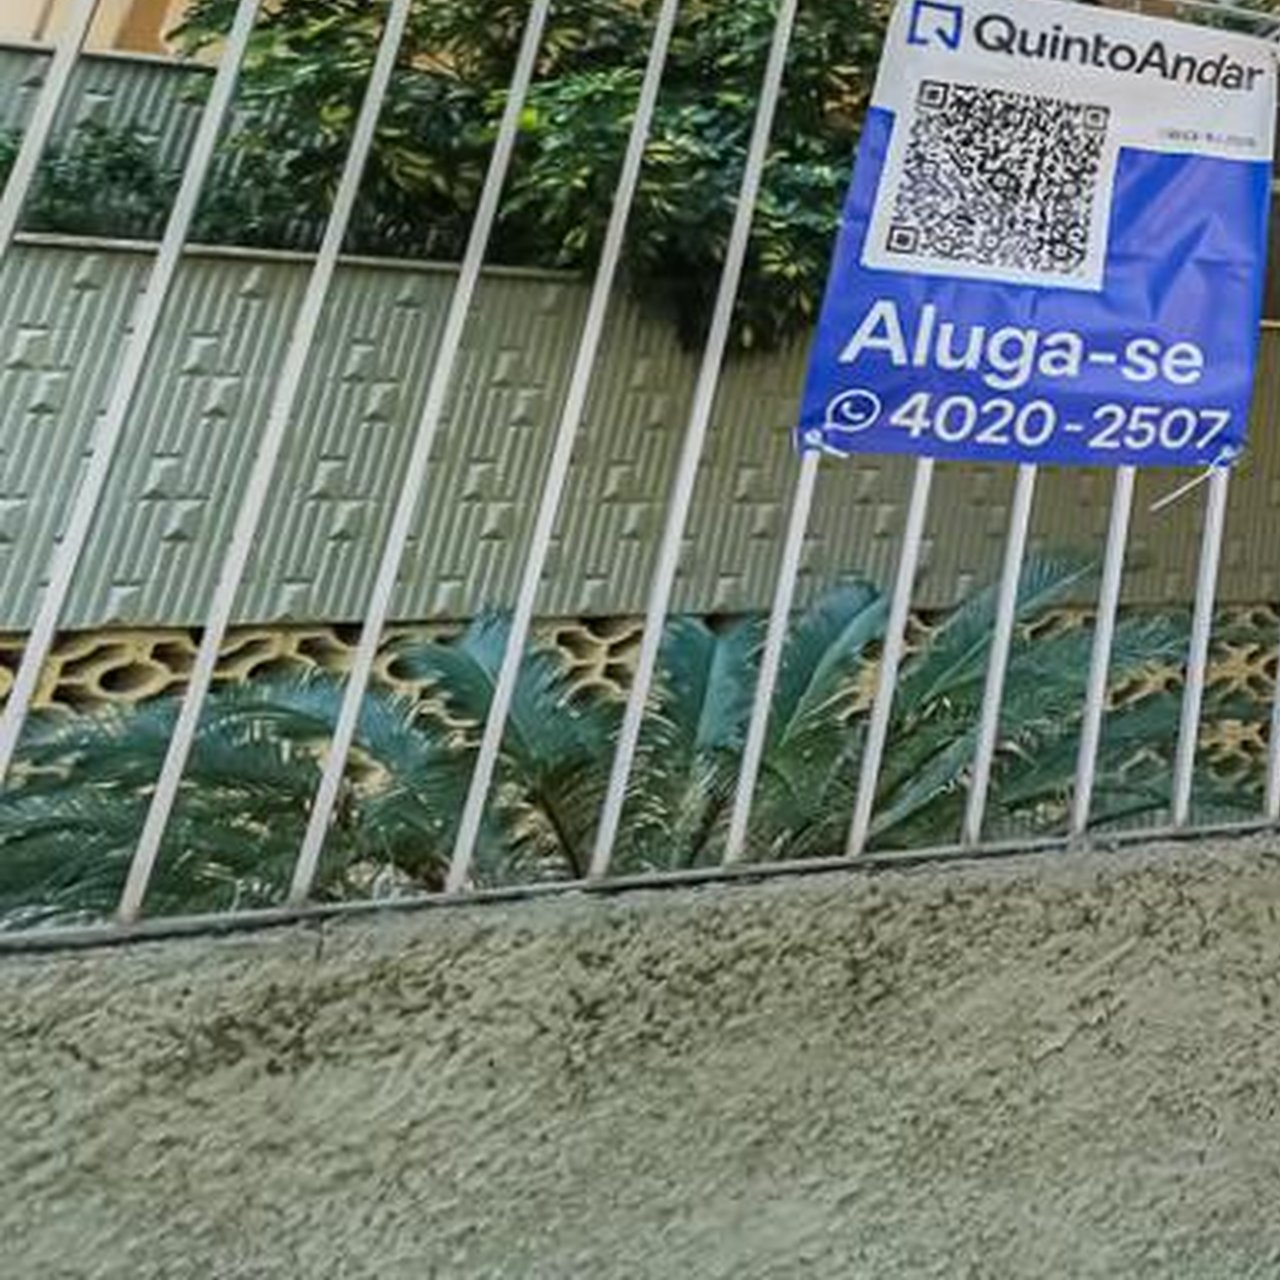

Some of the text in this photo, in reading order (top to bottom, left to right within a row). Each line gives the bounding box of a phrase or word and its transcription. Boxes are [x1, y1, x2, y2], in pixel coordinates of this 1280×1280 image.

[973, 14, 1266, 92] QuintoAndar
[839, 299, 1204, 391] Aluga-se
[890, 391, 1231, 450] 4020-2507
